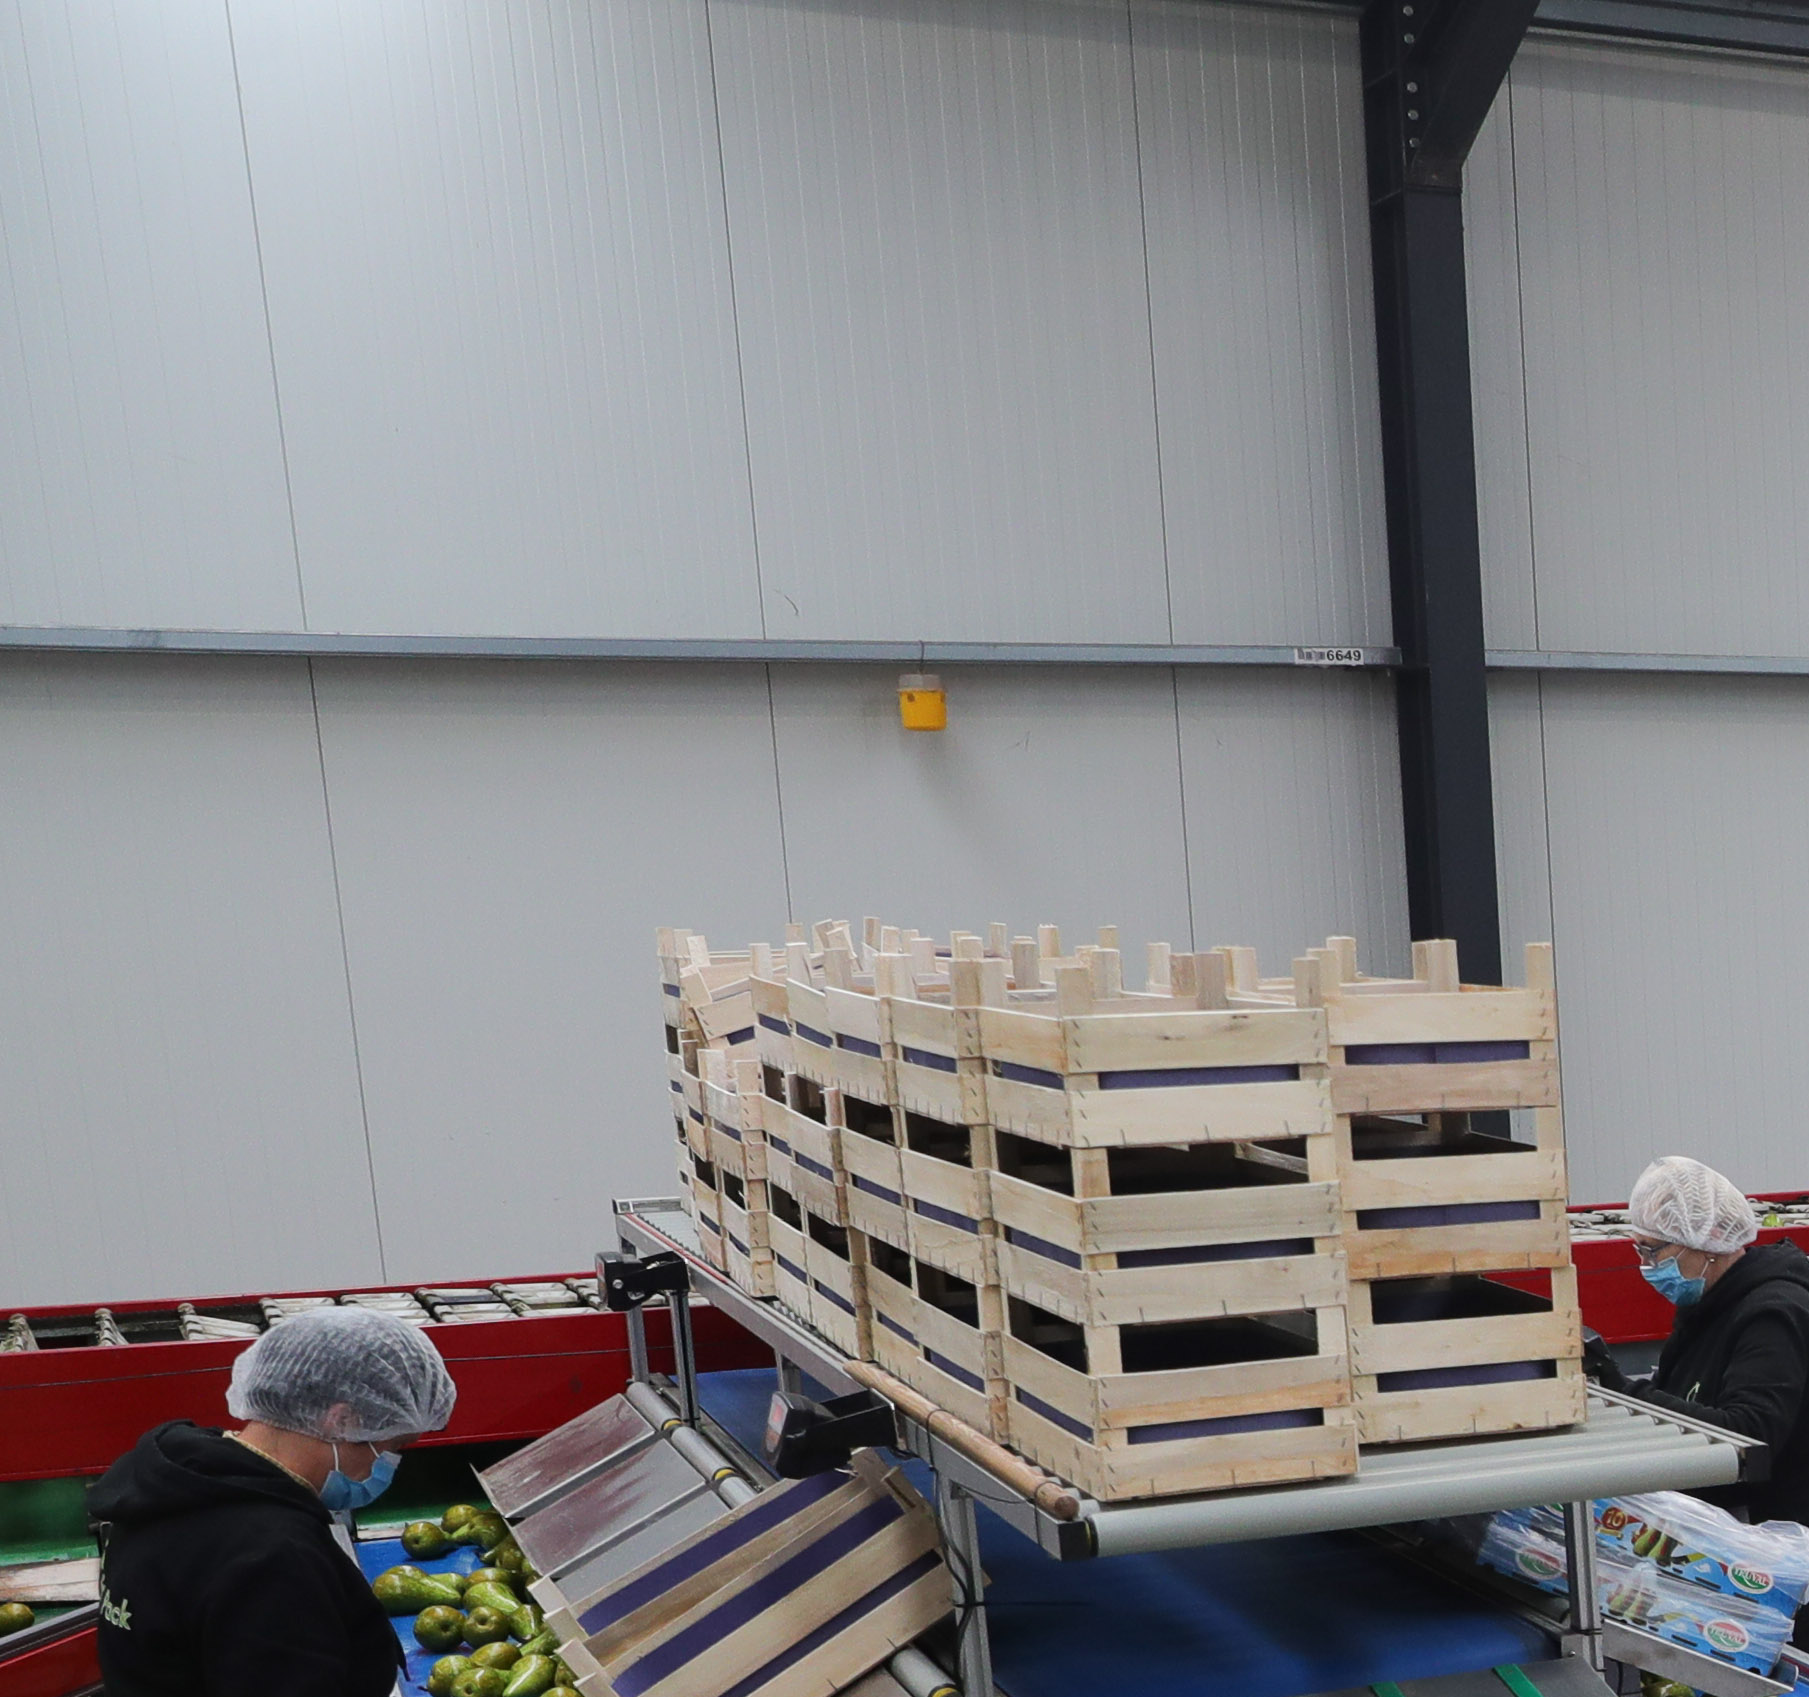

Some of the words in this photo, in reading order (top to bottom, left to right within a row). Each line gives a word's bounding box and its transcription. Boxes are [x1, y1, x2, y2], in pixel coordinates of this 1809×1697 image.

[1326, 649, 1362, 662] 6649
[1606, 1509, 1624, 1528] 10
[1735, 1568, 1768, 1587] TRUVAL
